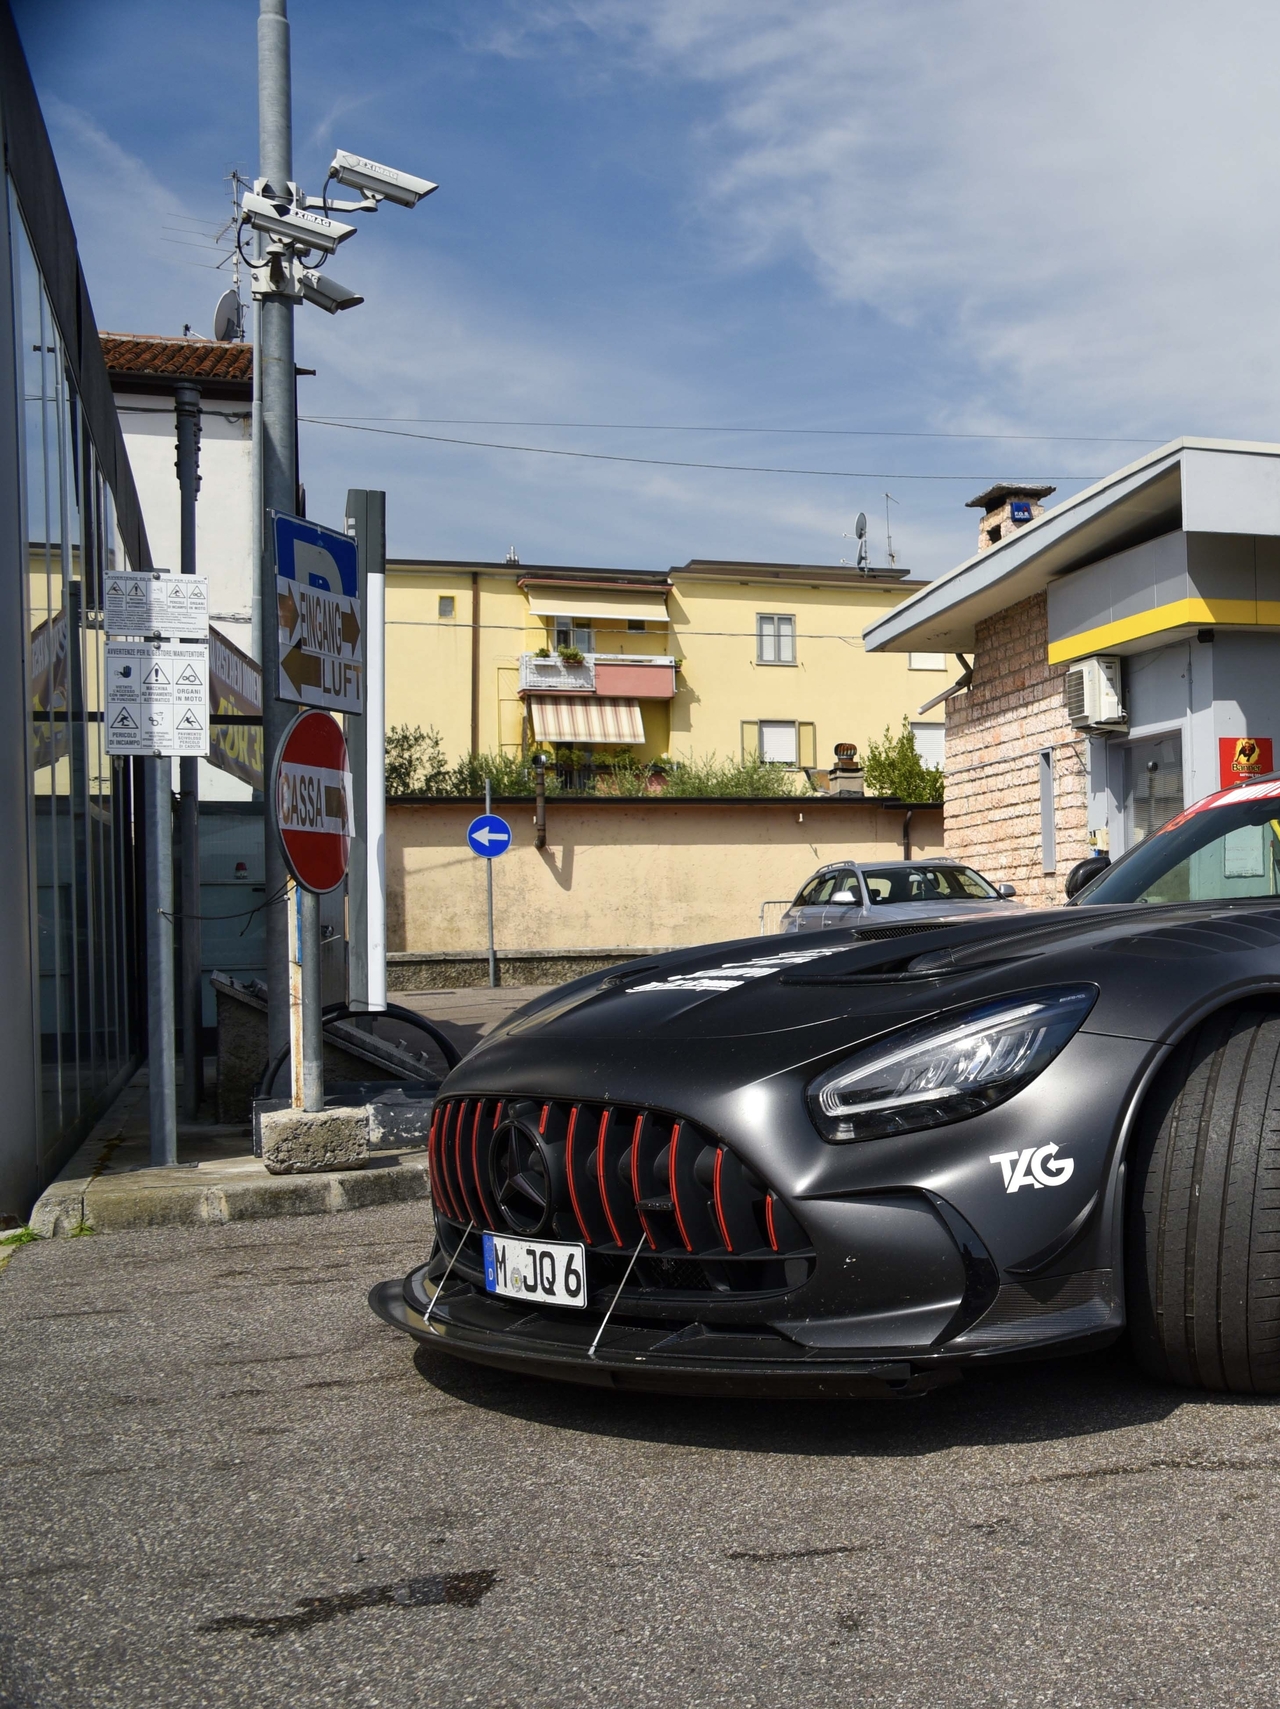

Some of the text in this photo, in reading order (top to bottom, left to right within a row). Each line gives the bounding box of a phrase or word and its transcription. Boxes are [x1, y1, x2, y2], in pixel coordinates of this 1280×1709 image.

[358, 160, 398, 181] EXIMAG
[289, 209, 331, 228] EXIMAG
[300, 591, 342, 656] EINGANG
[107, 648, 136, 656] AVVERTENZE
[322, 657, 363, 700] LUFT
[1231, 763, 1262, 772] Banner
[281, 772, 324, 828] CASSA
[989, 1141, 1075, 1194] TAG
[494, 1242, 582, 1299] M JQ 6
